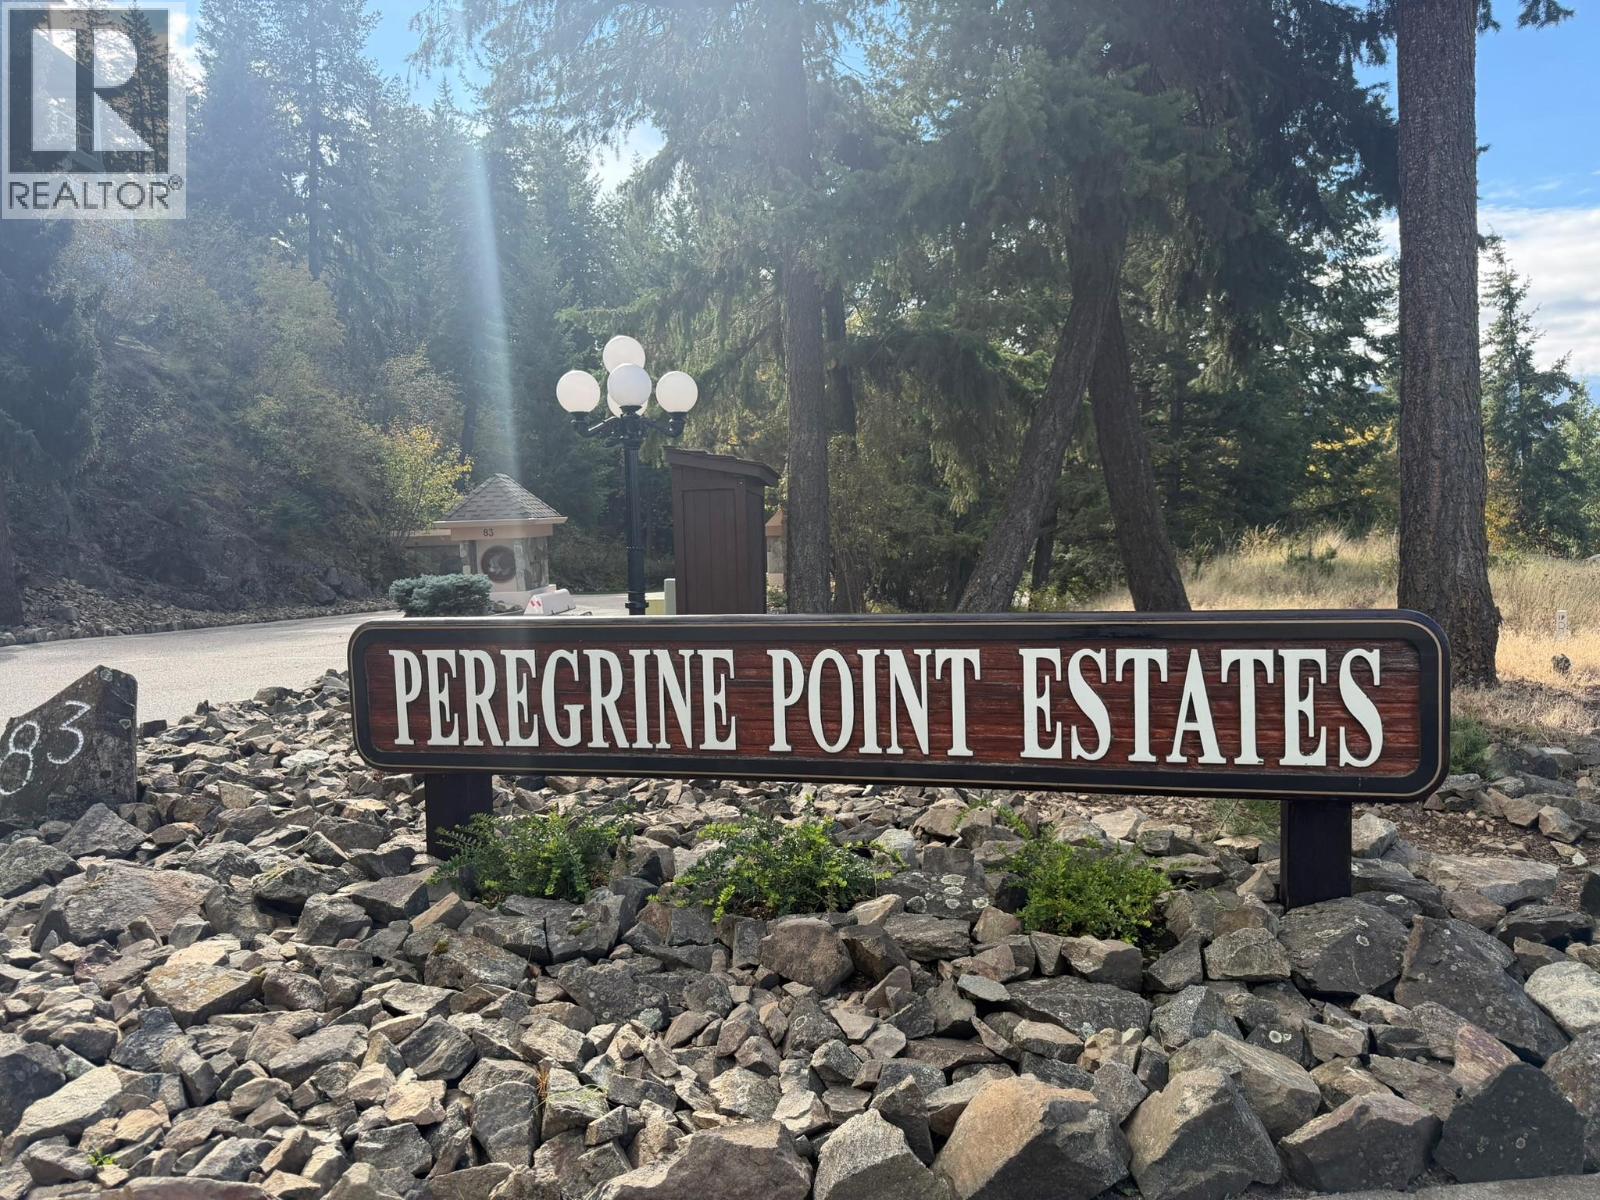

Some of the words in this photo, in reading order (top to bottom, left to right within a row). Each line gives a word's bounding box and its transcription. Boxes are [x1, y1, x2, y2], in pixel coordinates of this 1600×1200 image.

[482, 528, 494, 537] 83
[0, 700, 91, 795] 83
[388, 649, 738, 751] PEREGRINE
[766, 648, 981, 756] POINT
[1018, 648, 1384, 768] ESTATES
